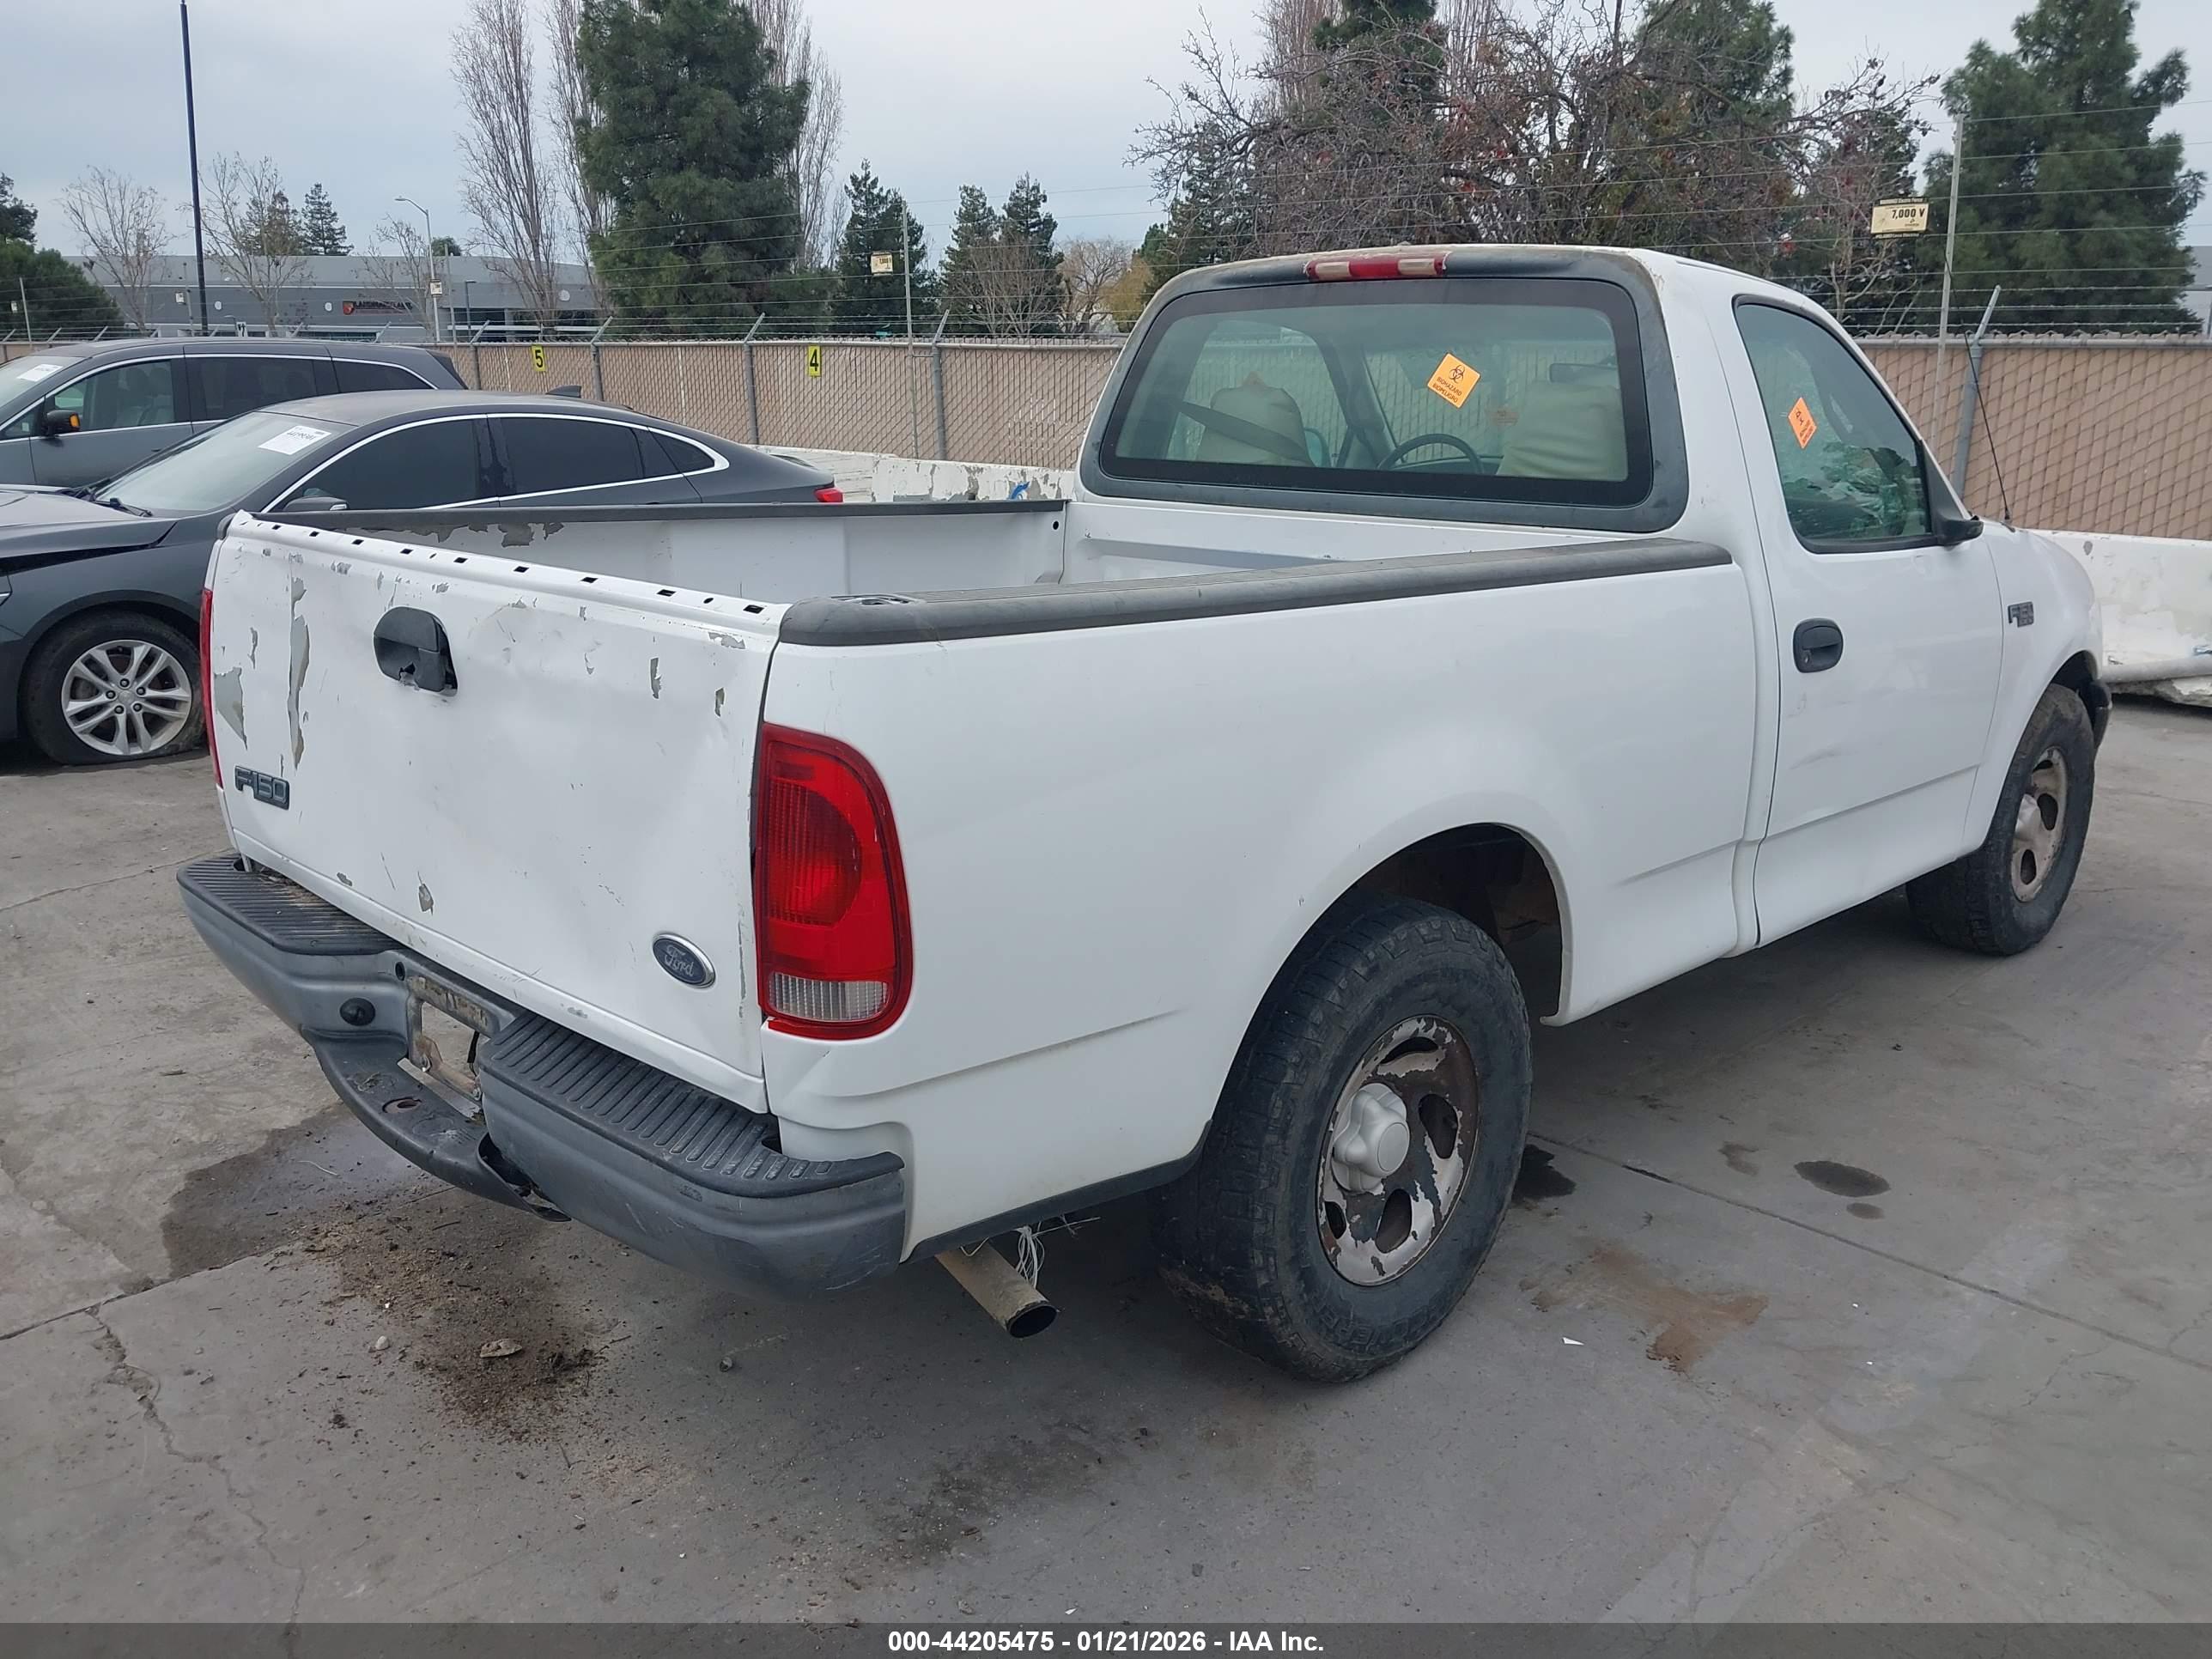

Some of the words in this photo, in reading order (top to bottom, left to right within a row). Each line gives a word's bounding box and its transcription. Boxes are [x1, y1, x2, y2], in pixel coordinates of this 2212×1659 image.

[1892, 208, 1917, 220] 7,000
[1919, 208, 1925, 217] V
[535, 349, 544, 368] 5
[810, 349, 819, 372] 4
[1432, 383, 1459, 403] BIOPELIGRO
[1437, 376, 1462, 396] BIOHAZARD
[664, 945, 696, 977] Ford
